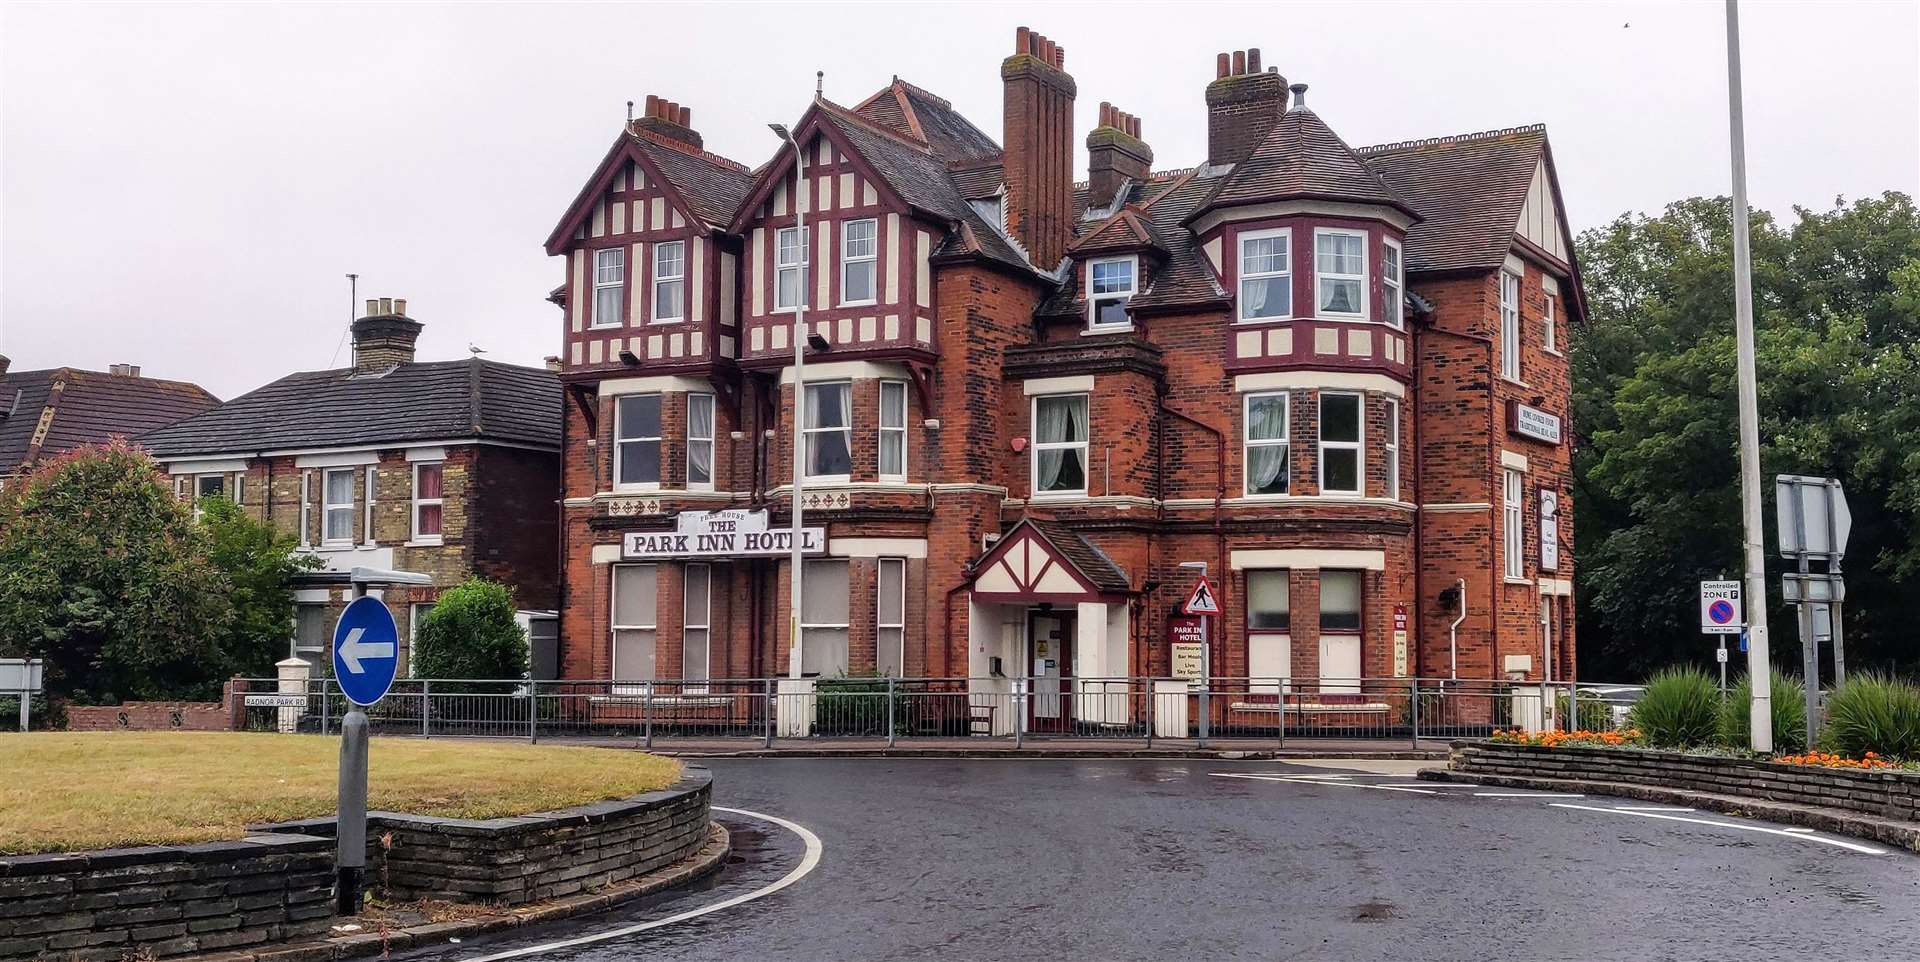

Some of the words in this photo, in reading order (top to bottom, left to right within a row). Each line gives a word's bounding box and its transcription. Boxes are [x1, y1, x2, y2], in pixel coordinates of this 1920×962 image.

[721, 511, 745, 521] HOUSE
[709, 520, 737, 532] THE
[633, 535, 689, 553] PARK
[697, 533, 736, 551] INN
[1703, 591, 1728, 599] ZONE
[246, 698, 275, 706] RADNOR
[295, 698, 305, 706] RD
